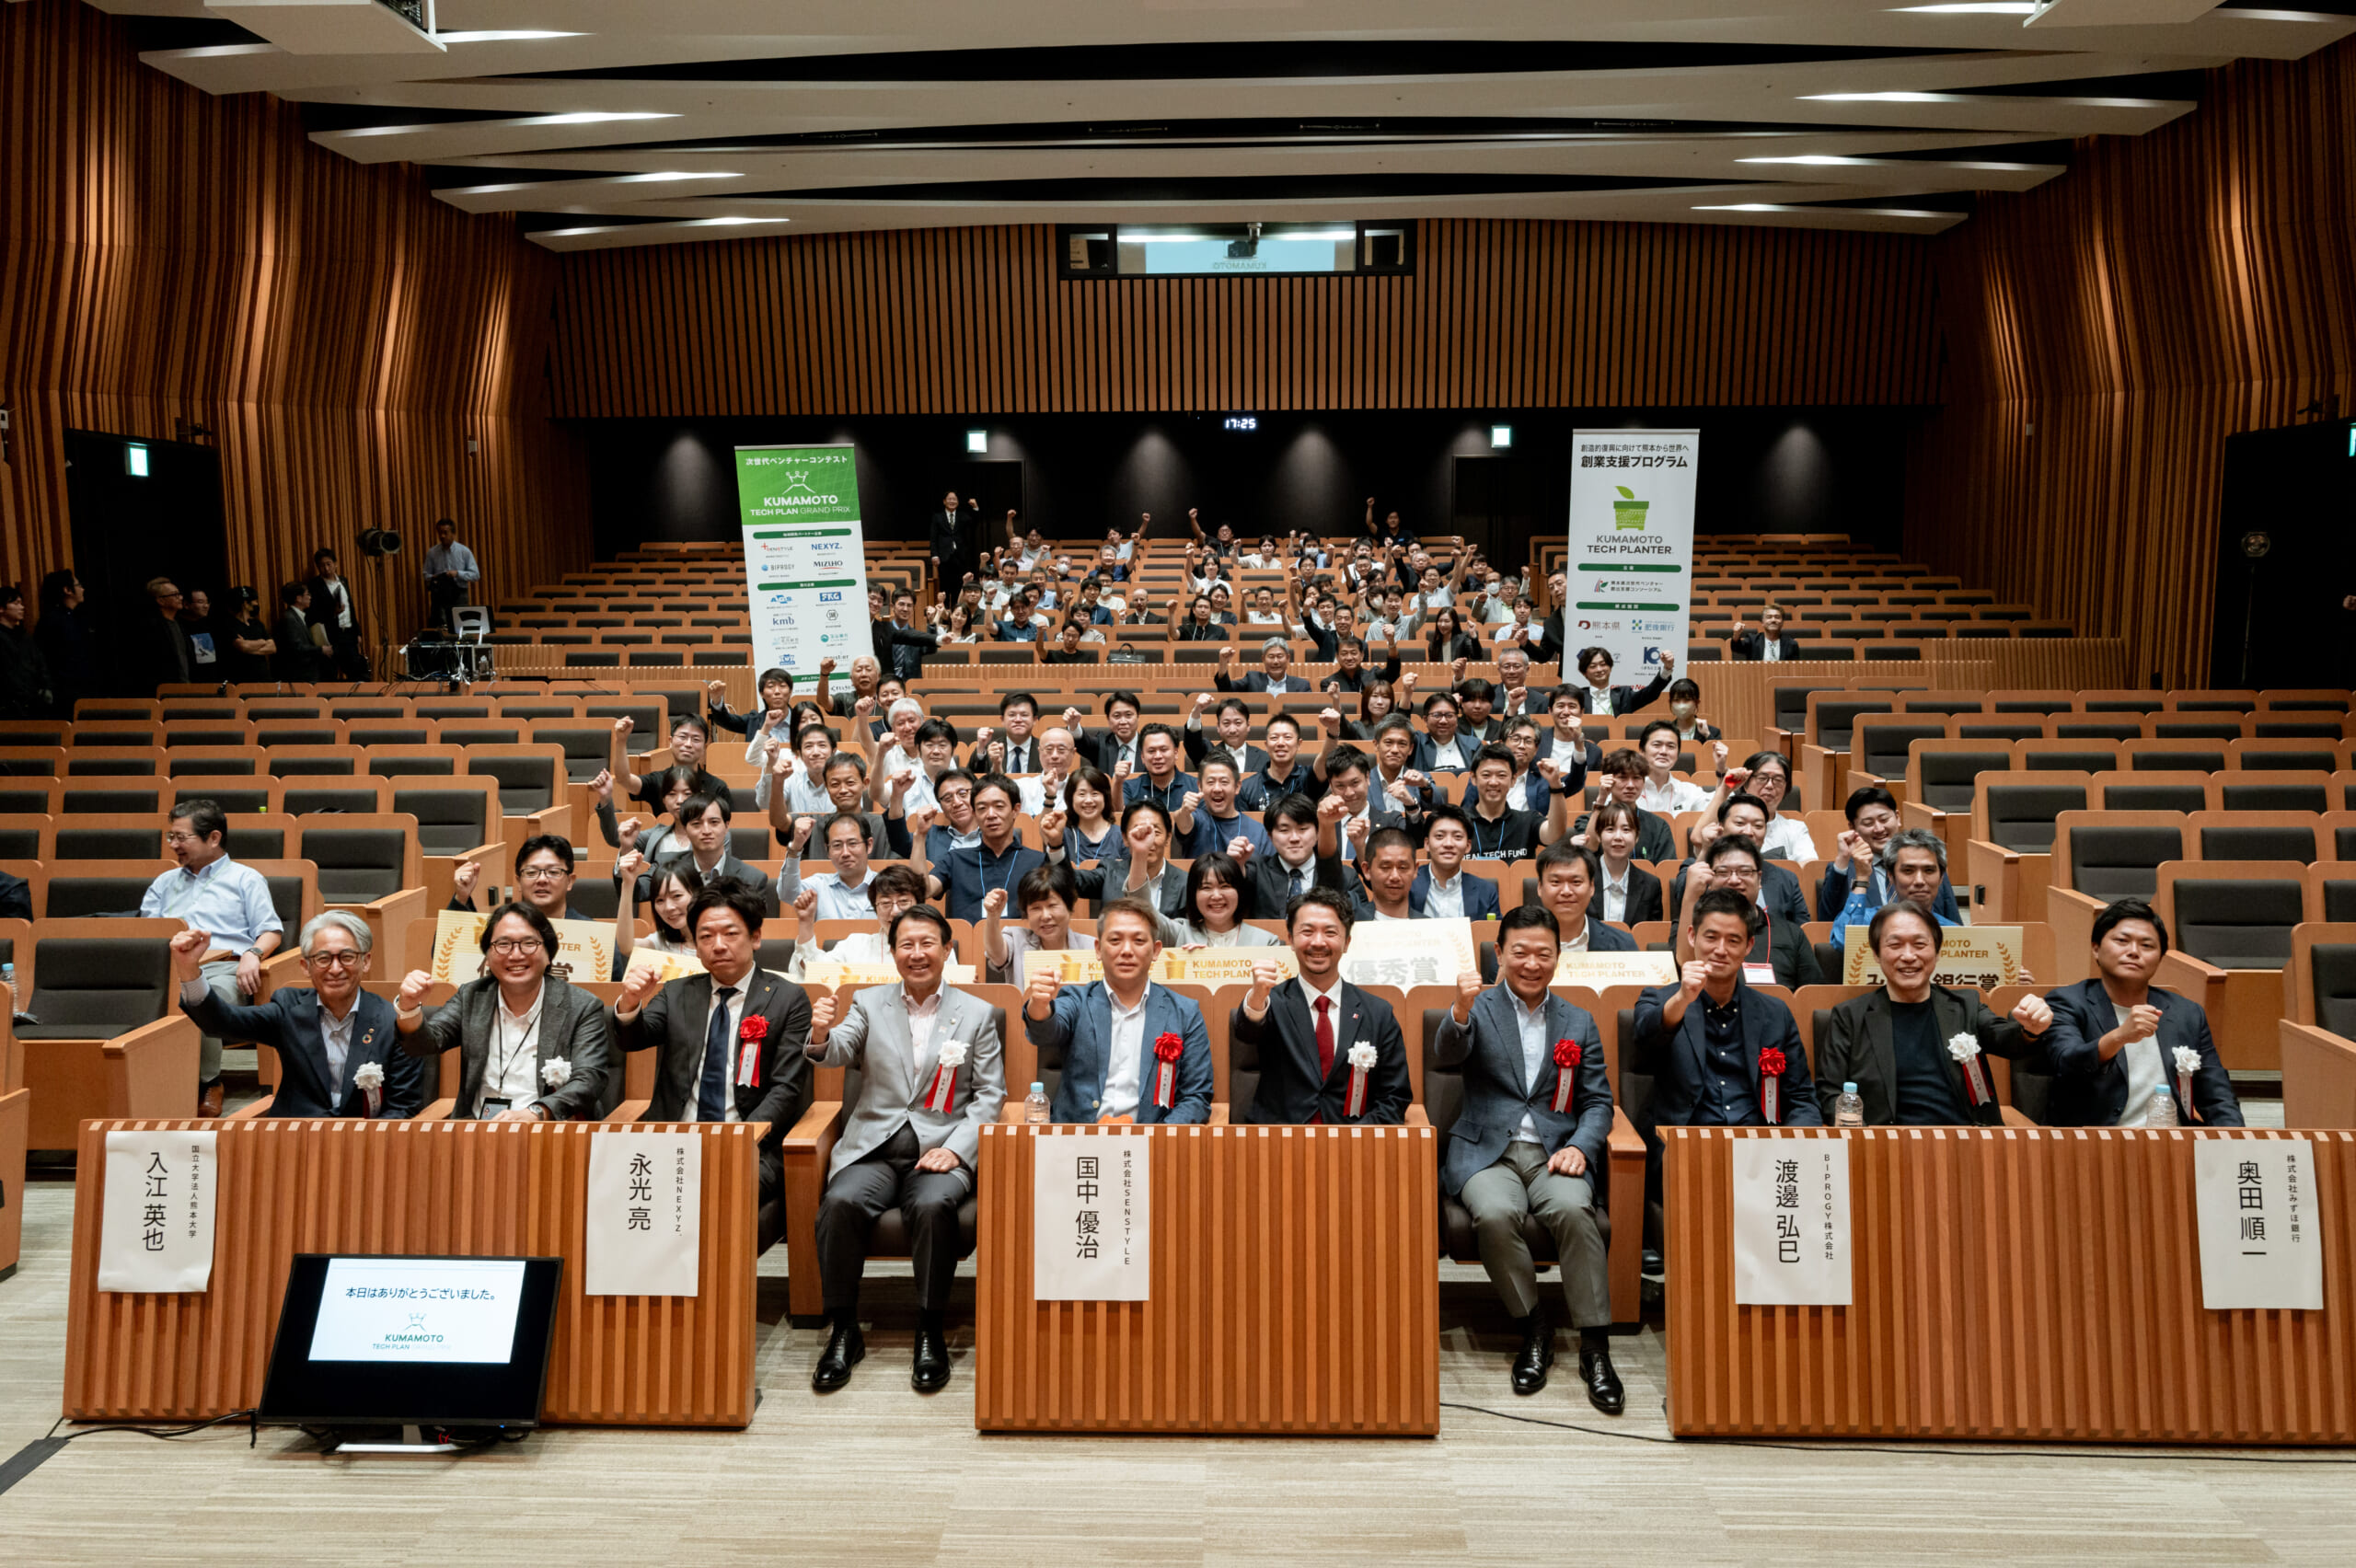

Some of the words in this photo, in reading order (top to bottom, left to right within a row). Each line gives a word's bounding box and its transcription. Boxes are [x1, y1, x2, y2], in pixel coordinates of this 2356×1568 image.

[1225, 418, 1256, 429] 17:25
[745, 455, 848, 466] 次世代ベンチャーコンテスト
[1581, 455, 1688, 467] 創業支援プログラム
[764, 495, 838, 507] KUMAMOTO
[775, 507, 799, 515] PLAN
[800, 506, 830, 514] GRAND
[832, 505, 851, 513] PRIX
[1597, 536, 1663, 544] KUMAMOTO
[1587, 545, 1617, 553] TECH
[1620, 545, 1672, 554] PLANTER
[773, 616, 795, 626] kmb
[1507, 847, 1528, 858] FUND
[1942, 940, 1971, 948] MOTO
[1940, 950, 1989, 958] PLANTER
[1193, 959, 1253, 968] KUMAMOTO
[1193, 971, 1220, 979] TECH
[189, 1145, 200, 1239] 国立大学法人熊本大学
[629, 1153, 653, 1230] 永光亮
[142, 1152, 168, 1251] 入江英也
[2287, 1155, 2300, 1243] 株式会社みずほ銀行
[1075, 1157, 1100, 1259] 国中優治
[1123, 1150, 1132, 1265] 株式会社SENSTYLE
[1824, 1154, 1834, 1260] BIPROGY株式会社
[2237, 1160, 2267, 1255] 奥田順一
[345, 1287, 495, 1300] 本日はありがとうございました。
[385, 1333, 444, 1343] KUMAMOTO
